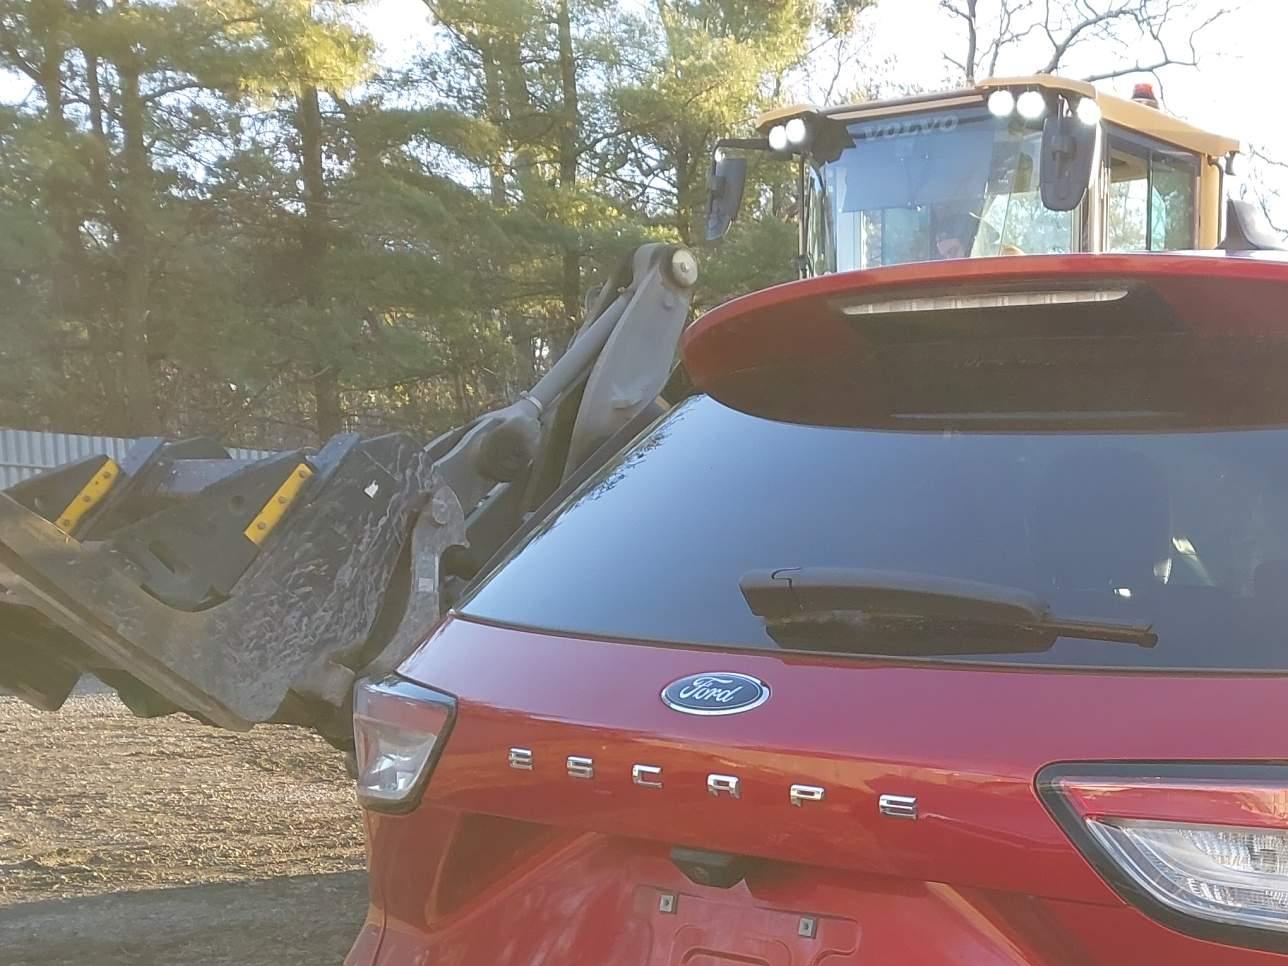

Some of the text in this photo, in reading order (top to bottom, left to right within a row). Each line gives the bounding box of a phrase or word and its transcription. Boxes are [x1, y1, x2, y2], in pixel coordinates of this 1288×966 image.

[864, 112, 959, 141] VOLVO
[679, 676, 742, 703] Ford
[508, 747, 919, 820] ESCAPE
